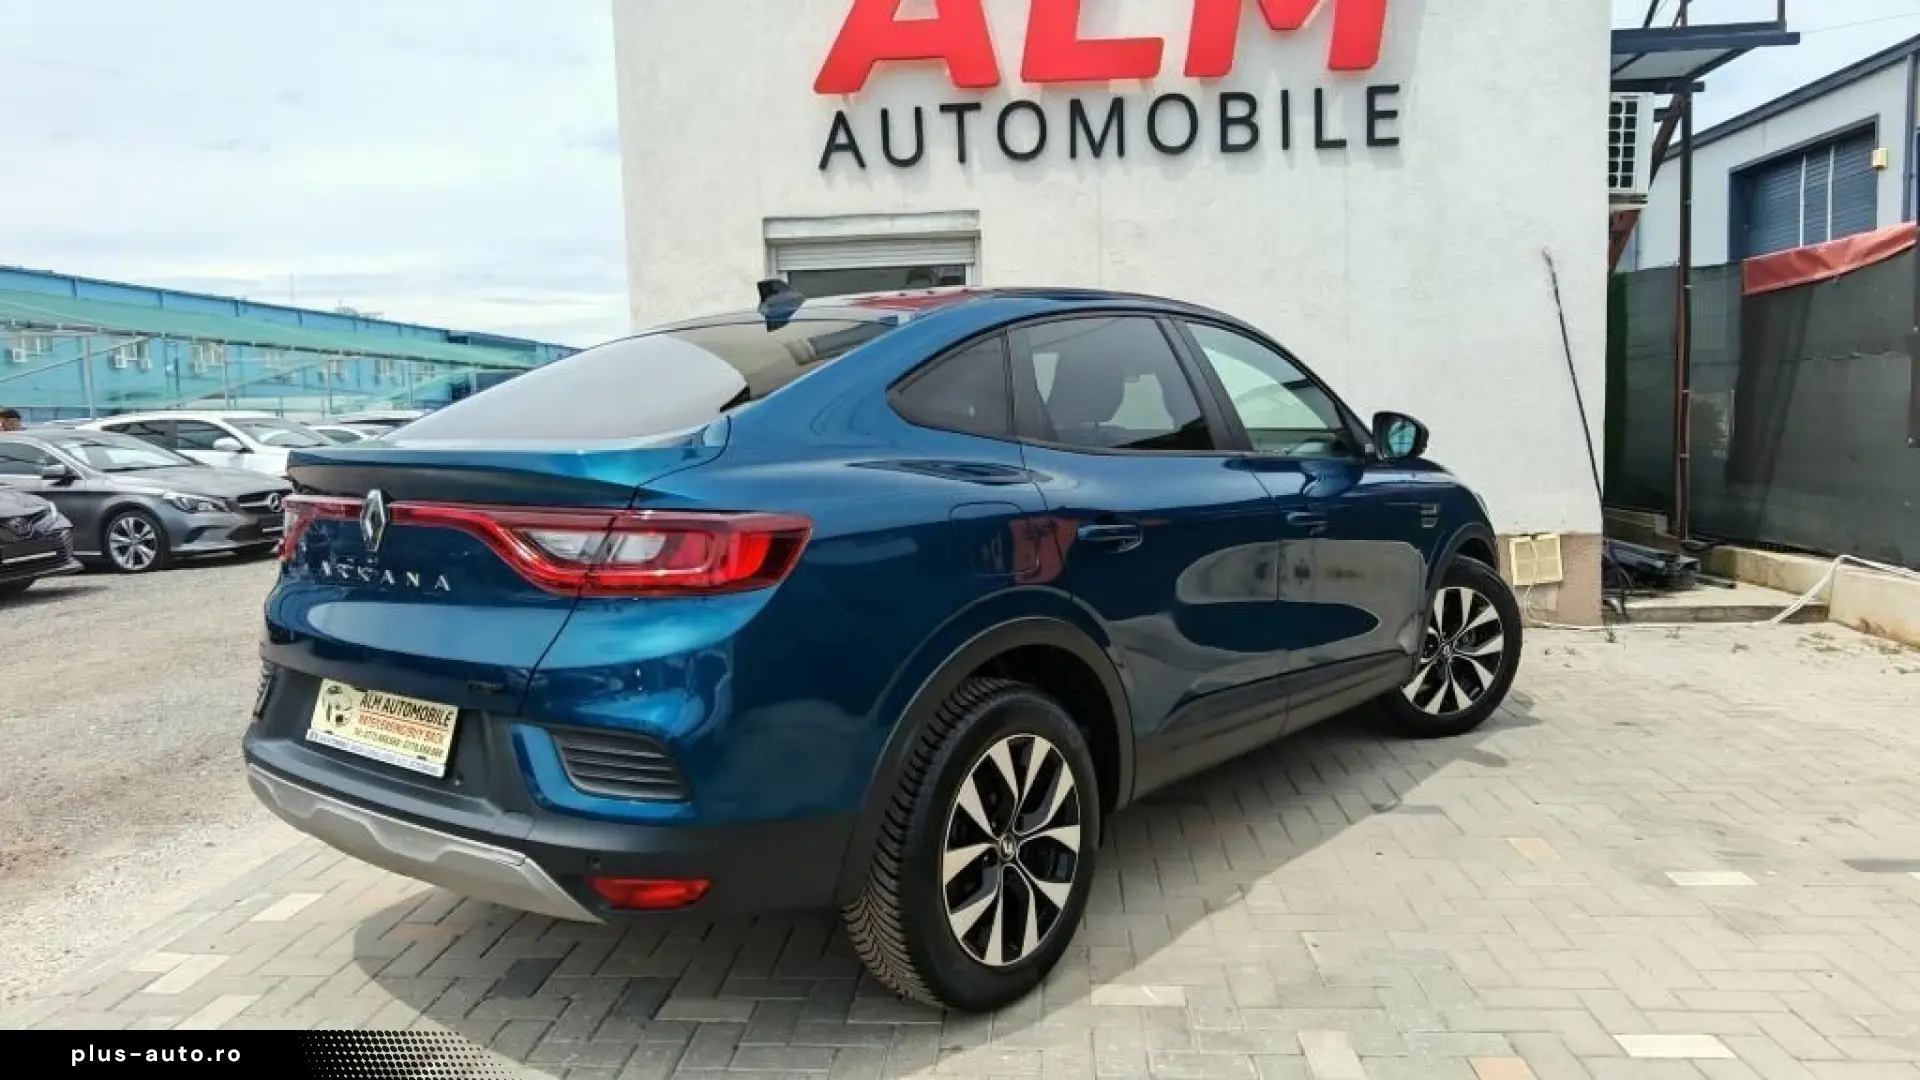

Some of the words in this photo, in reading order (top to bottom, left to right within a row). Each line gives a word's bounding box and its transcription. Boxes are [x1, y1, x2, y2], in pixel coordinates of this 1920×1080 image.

[819, 84, 1400, 170] AUTOMOBILE
[360, 692, 383, 711] ALM
[382, 697, 454, 728] AUTOMOBILE
